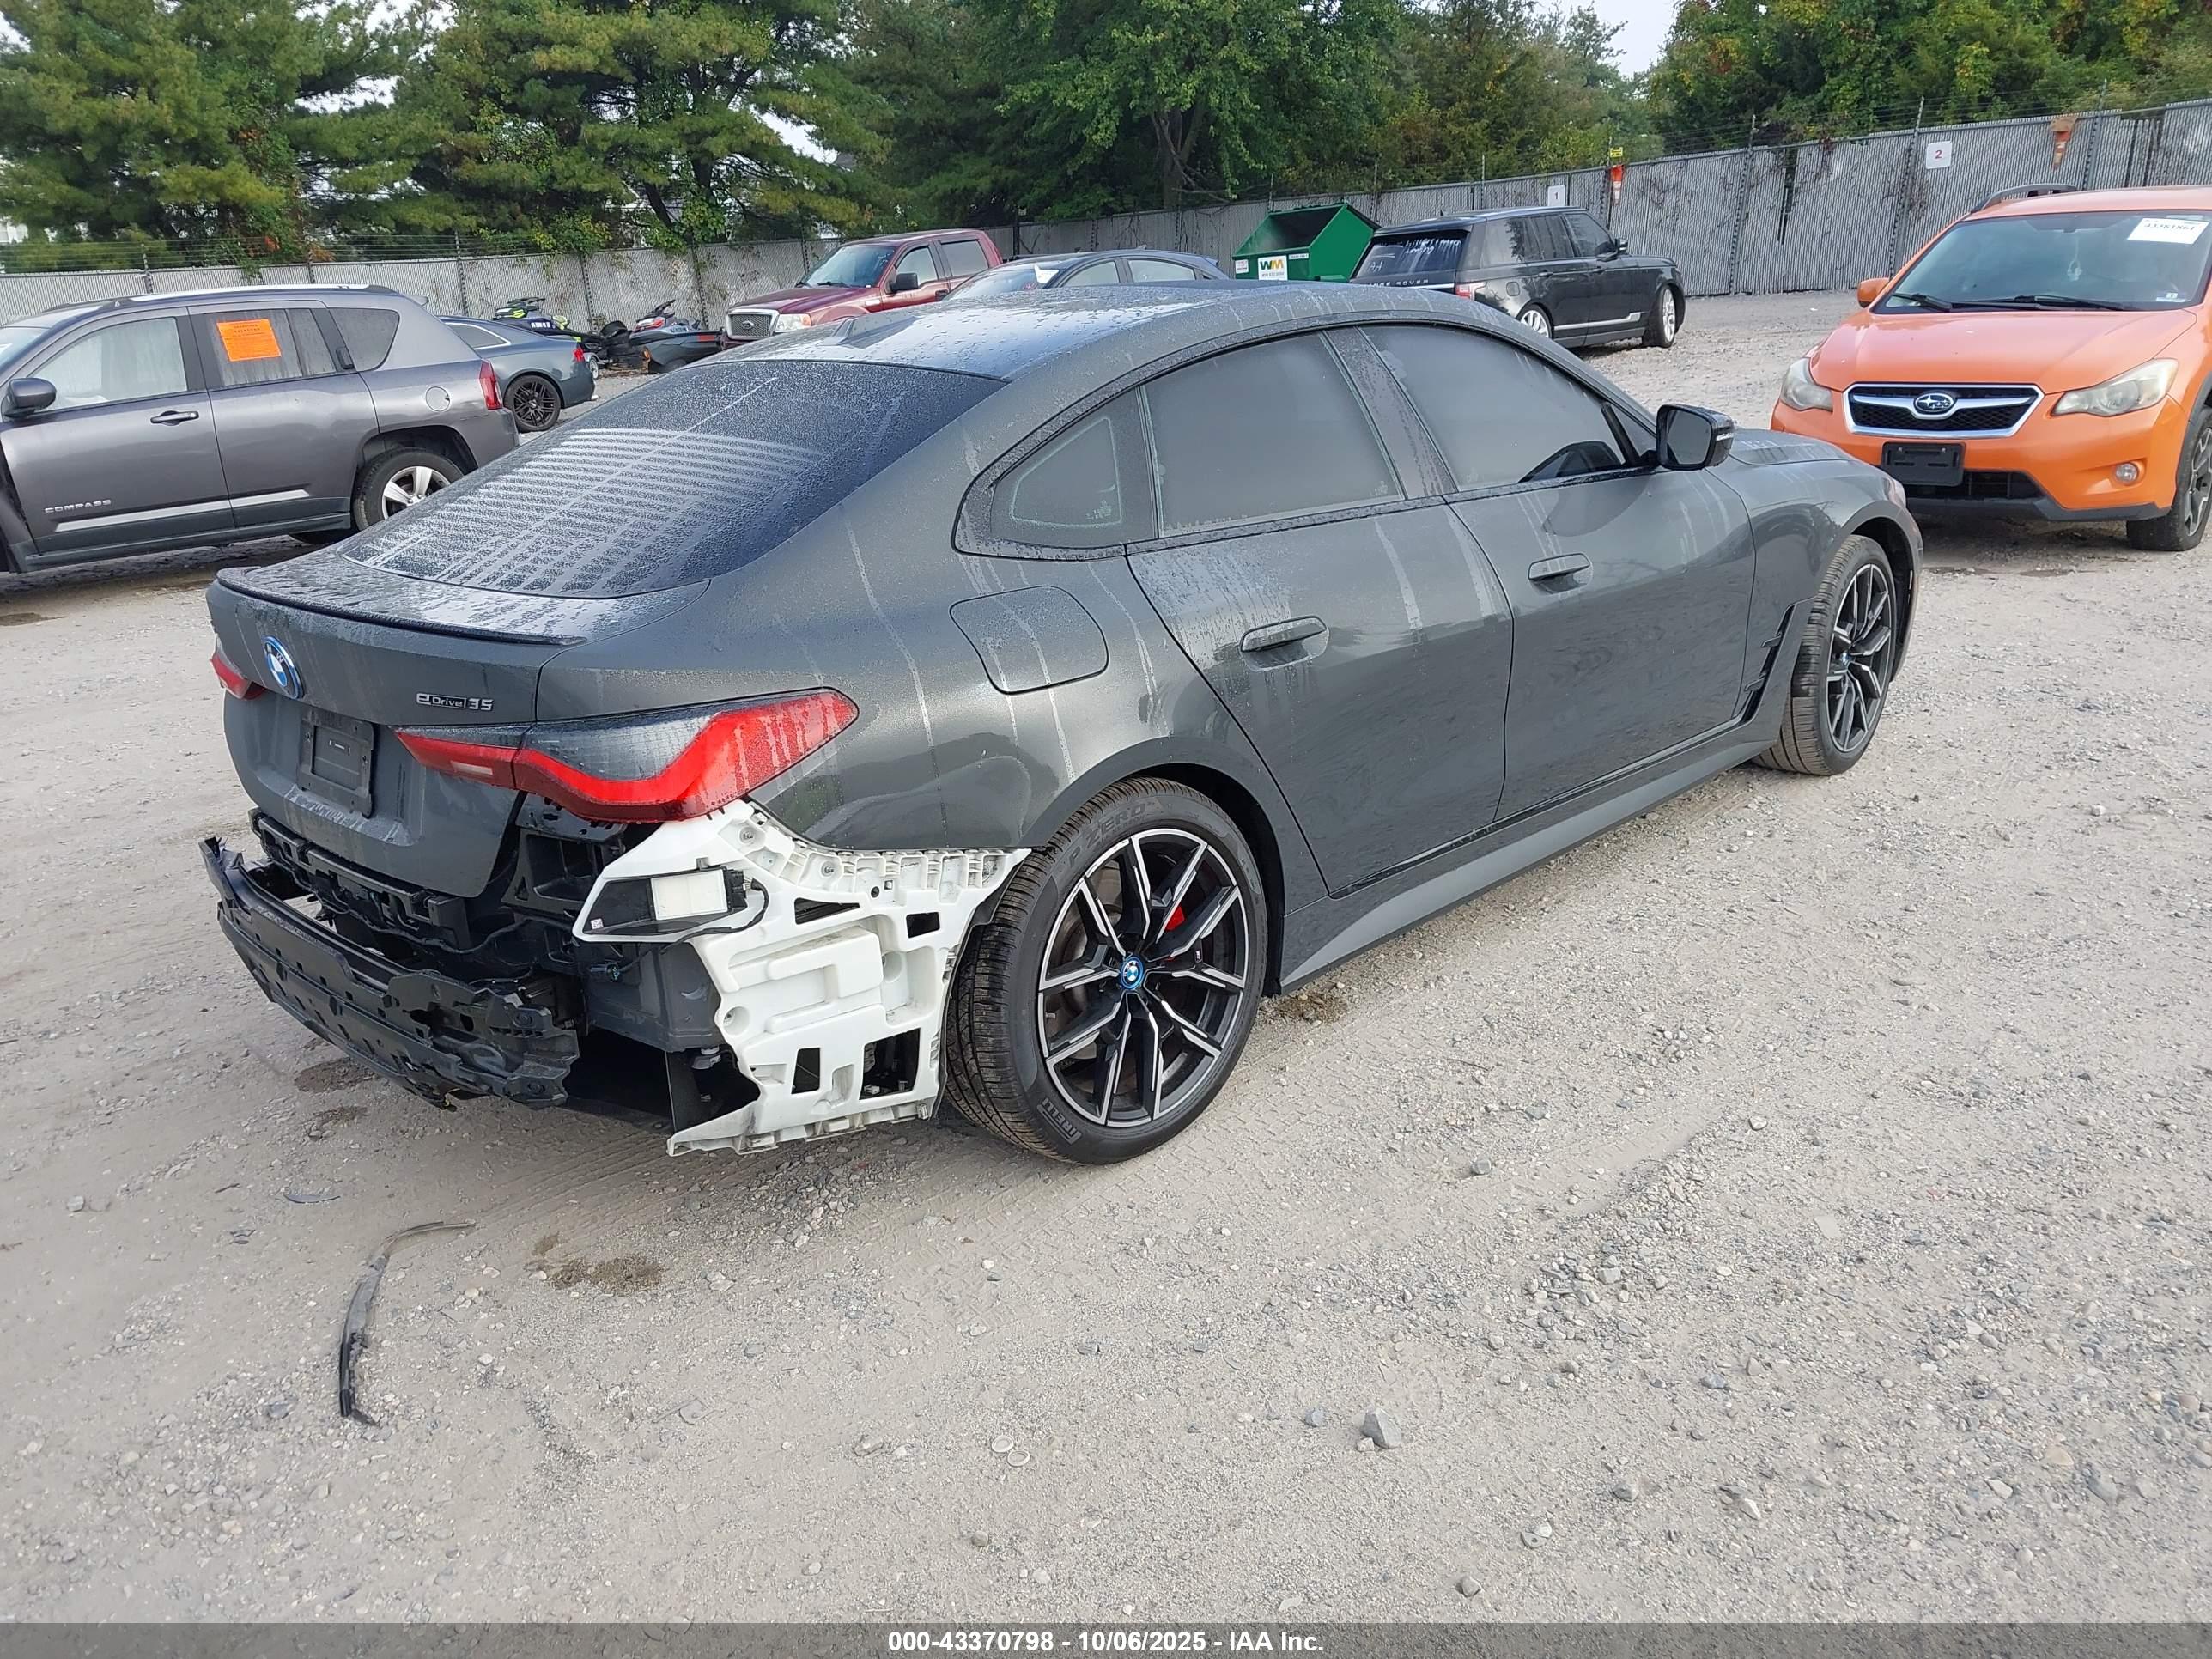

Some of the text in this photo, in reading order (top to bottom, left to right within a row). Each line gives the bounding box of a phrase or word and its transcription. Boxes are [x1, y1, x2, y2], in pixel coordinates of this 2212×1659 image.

[1935, 149, 1942, 159] 2
[1260, 259, 1284, 270] WM
[45, 500, 111, 513] COMPASS
[1086, 803, 1146, 848] ZERO
[1037, 1097, 1082, 1145] PIRELLI
